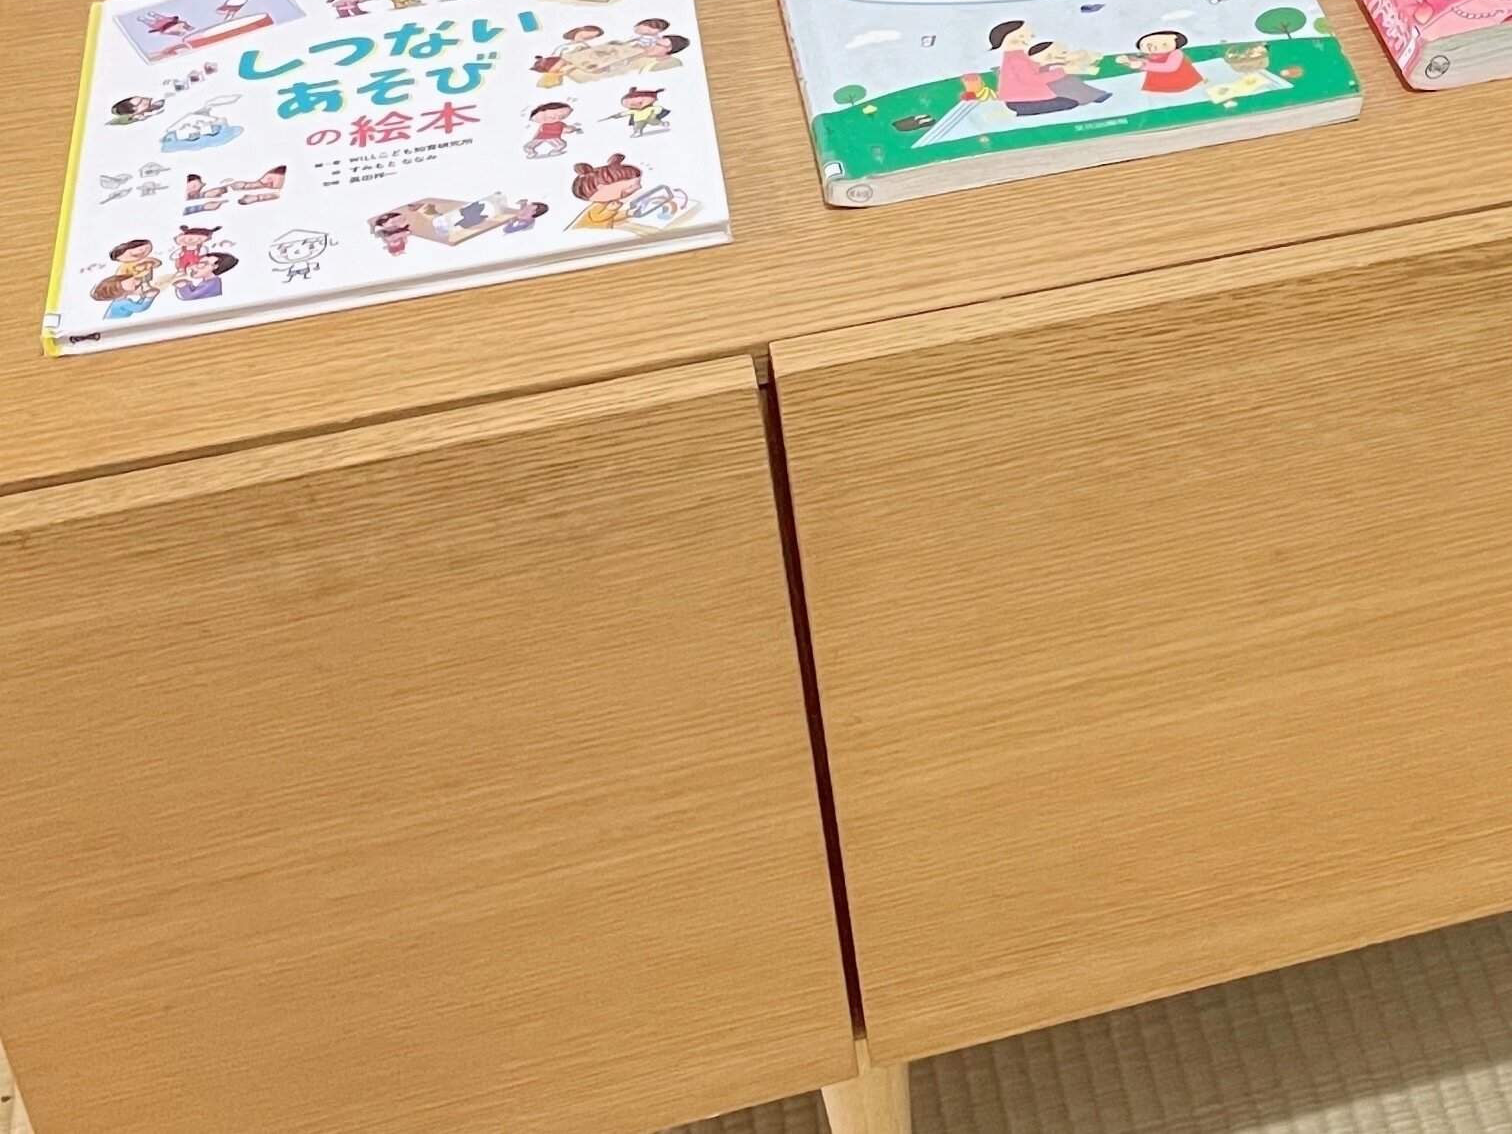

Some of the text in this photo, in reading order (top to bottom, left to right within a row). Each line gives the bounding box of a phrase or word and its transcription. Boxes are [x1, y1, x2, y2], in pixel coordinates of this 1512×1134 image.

[239, 11, 539, 80] しつない
[277, 52, 498, 120] あそび
[306, 102, 480, 148] の絵本
